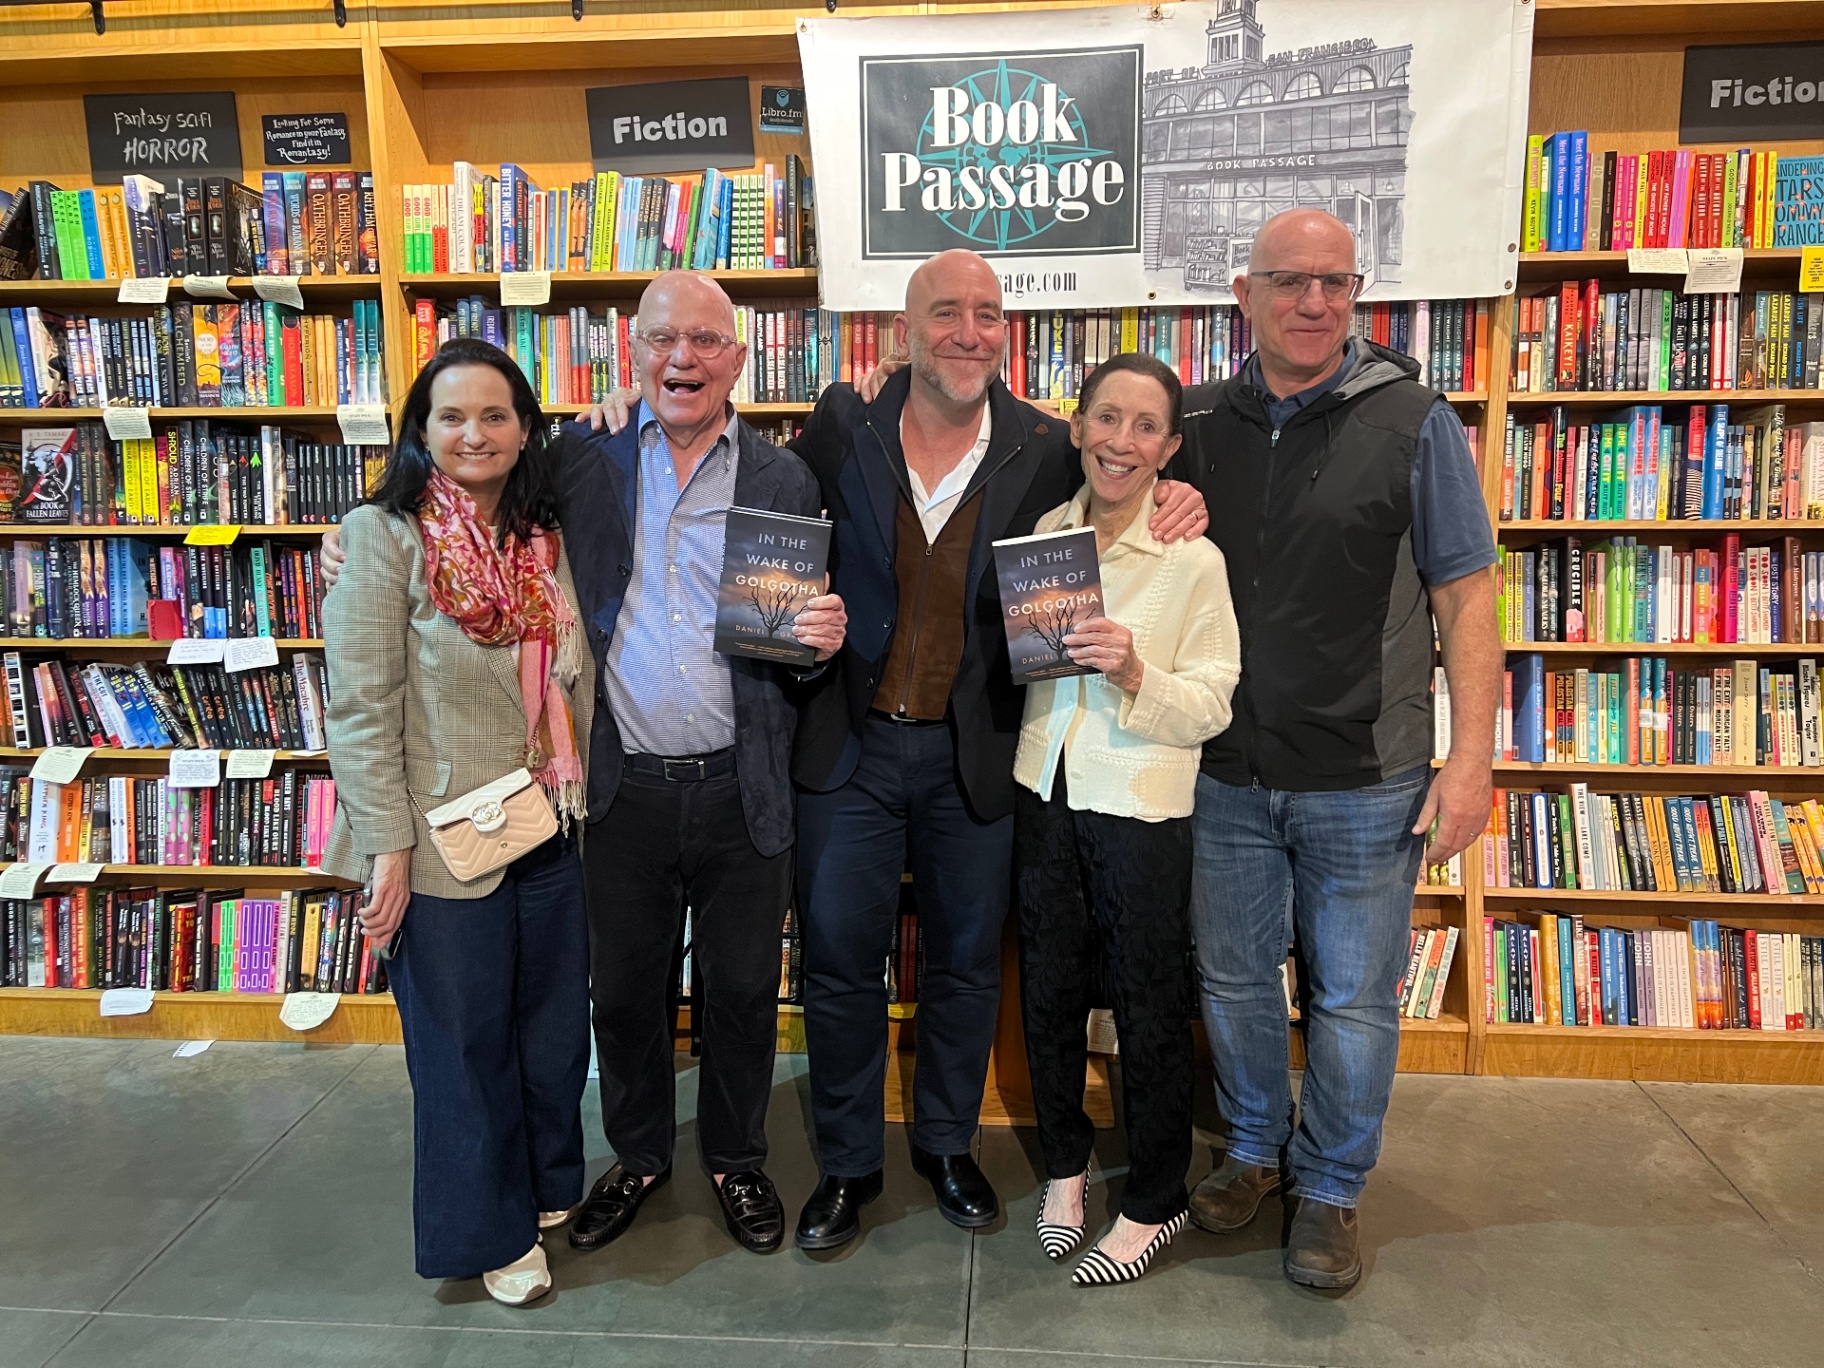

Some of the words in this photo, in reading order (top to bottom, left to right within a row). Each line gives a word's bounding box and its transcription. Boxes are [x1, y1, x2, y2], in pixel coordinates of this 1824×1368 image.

[1268, 51, 1292, 66] SAN
[114, 108, 171, 135] Fantasy
[762, 107, 802, 117] Libro.fm
[930, 83, 1077, 148] Book
[273, 119, 299, 129] Looking
[300, 118, 312, 126] For
[314, 117, 335, 126] Some
[613, 112, 727, 144] Fiction
[266, 131, 296, 142] Romance
[304, 130, 319, 138] your
[292, 139, 307, 147] Find
[1576, 138, 1584, 152] Meet
[123, 137, 209, 165] HORROR
[276, 144, 331, 163] Romantasy!
[1559, 154, 1567, 166] the
[1575, 153, 1583, 165] the
[1207, 160, 1241, 170] BOOK
[1253, 154, 1316, 168] PASSAGE
[502, 168, 512, 198] BITTER
[881, 152, 1125, 223] Passage
[1557, 167, 1565, 195] Newmans
[1573, 166, 1582, 194] Newmans
[1776, 177, 1824, 201] TARS
[457, 198, 467, 228] DREAM
[502, 200, 512, 228] HONEY
[1774, 202, 1824, 222] OMMY
[313, 194, 328, 256] OATHBRINGER
[338, 194, 351, 256] OATHBRINGER
[458, 230, 467, 257] COUNT
[304, 318, 312, 359] HYPERION
[1563, 324, 1574, 366] KAIKEYI
[175, 317, 186, 386] ALCHEMISED
[75, 376, 84, 394] PEACE
[85, 376, 93, 393] PEACE
[1718, 412, 1726, 420] THE
[168, 431, 177, 464] SHROUD
[1557, 433, 1565, 448] The
[201, 471, 208, 480] OF
[1556, 449, 1565, 482] Johnson
[1615, 471, 1625, 481] IT
[1603, 472, 1611, 482] IT
[1554, 483, 1562, 502] Four
[26, 509, 48, 518] FALLEN
[49, 510, 69, 518] LEAVES
[40, 502, 58, 510] BOOK
[758, 533, 775, 545] IN
[781, 536, 807, 550] THE
[746, 554, 789, 569] WAKE
[795, 561, 814, 573] OF
[1020, 555, 1038, 568] IN
[1044, 549, 1073, 564] THE
[1013, 576, 1060, 592] WAKE
[1066, 571, 1087, 583] OF
[1571, 550, 1580, 604] CRUCIBLE
[1771, 564, 1779, 580] LOST
[736, 575, 819, 596] GOLGOTHA
[1771, 582, 1779, 604] STORY
[1008, 592, 1099, 617] GOLGOTHA
[736, 625, 765, 635] DANIEL
[1022, 654, 1054, 664] DANIEL
[295, 660, 303, 674] The
[299, 677, 309, 712] Macabre
[1565, 676, 1573, 709] POLOSTAN
[1622, 798, 1630, 820] BEASTS
[1644, 941, 1652, 966] JOHN
[1760, 941, 1768, 962] STILL
[1773, 943, 1781, 964] STILL
[1751, 973, 1759, 994] CALLAN
[1761, 967, 1769, 984] LIFE
